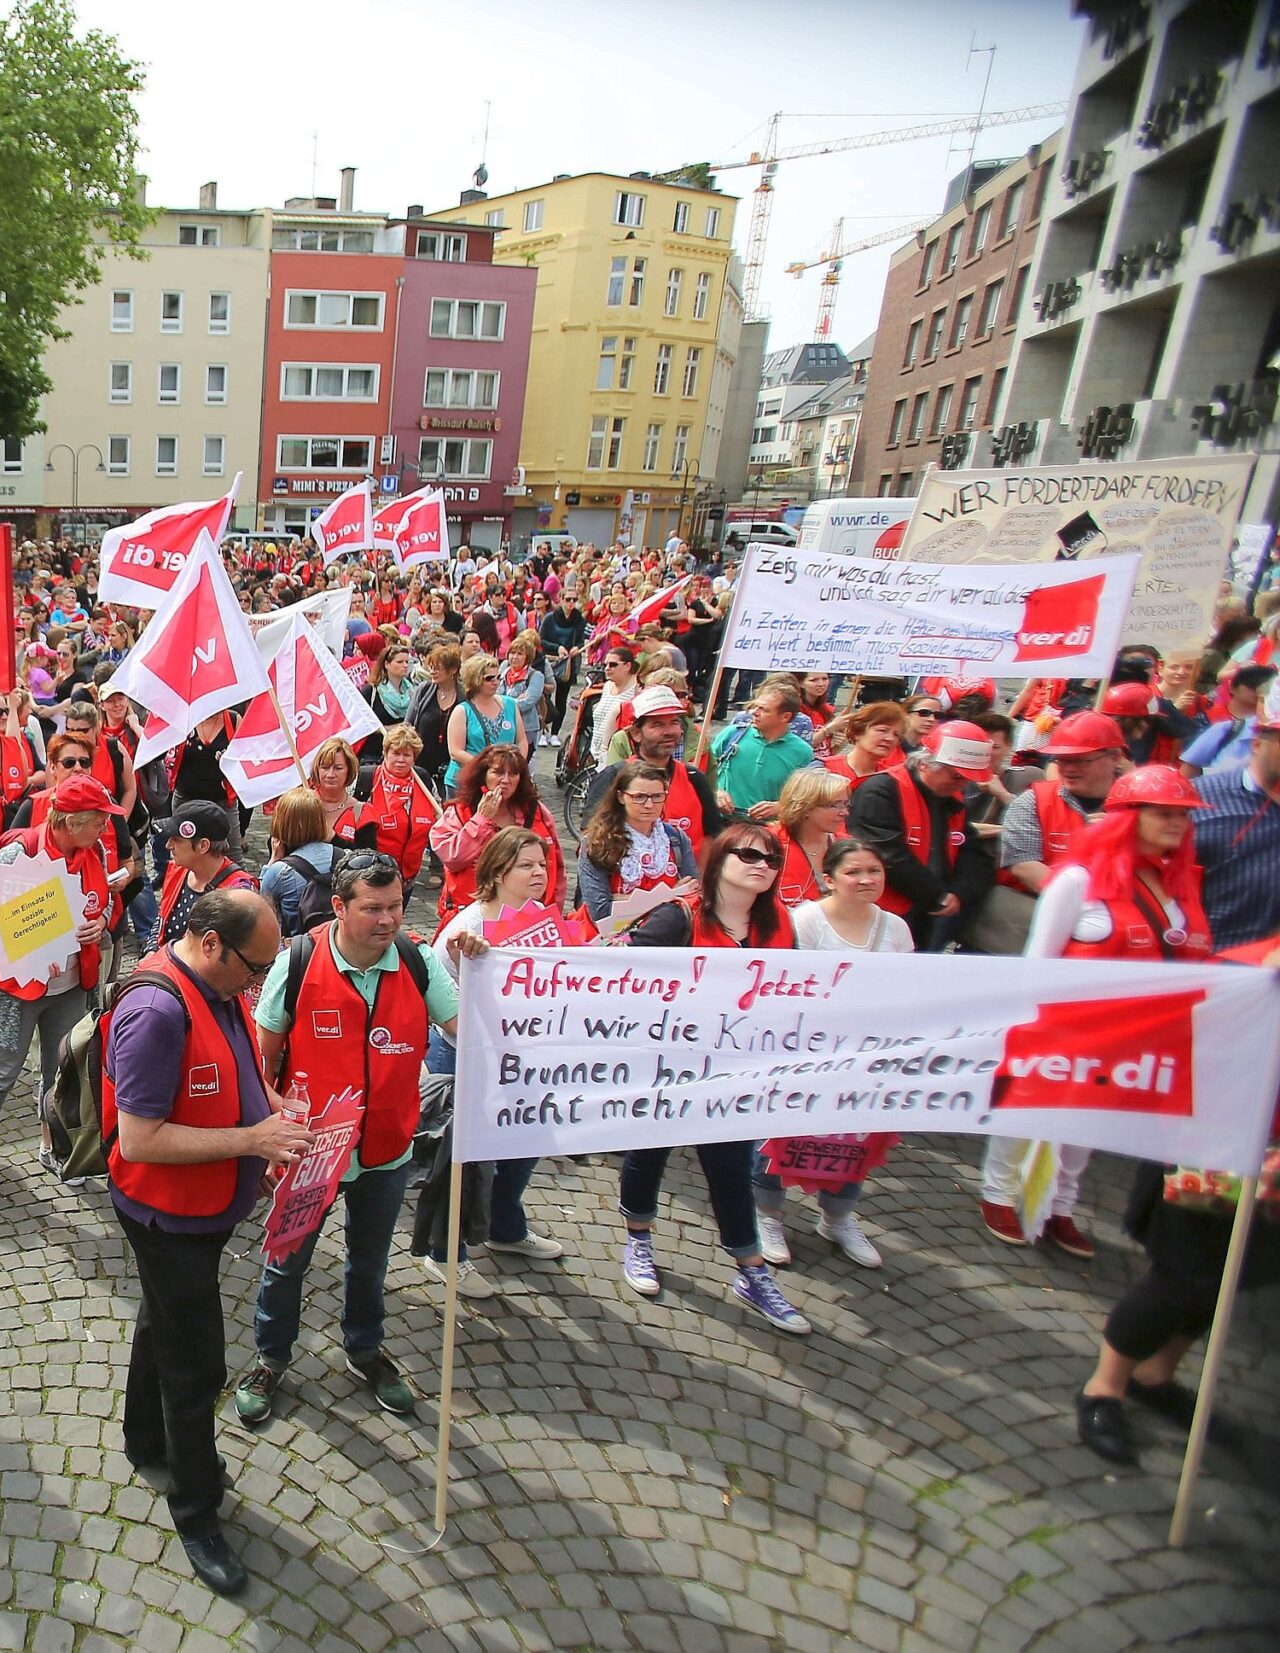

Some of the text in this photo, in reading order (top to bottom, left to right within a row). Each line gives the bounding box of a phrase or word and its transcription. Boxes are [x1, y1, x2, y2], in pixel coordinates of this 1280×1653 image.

[383, 479, 395, 490] U
[922, 482, 999, 523] WER
[838, 566, 869, 584] was
[870, 563, 892, 586] du
[820, 582, 851, 602] und
[878, 590, 912, 609] sag
[915, 585, 946, 603] dir
[950, 587, 981, 606] wer
[875, 619, 897, 635] die
[1021, 625, 1092, 647] ver.di
[1121, 619, 1195, 633] EAUFTRAGTE
[734, 635, 762, 650] den
[770, 633, 802, 651] Wert
[770, 653, 821, 670] besser
[830, 654, 885, 671] bezahlt
[21, 896, 46, 912] Einsatz
[45, 891, 56, 900] für
[21, 908, 45, 924] soziale
[501, 955, 853, 1011] Aufwertung! Jetzt!
[316, 1026, 339, 1034] ver.di
[501, 1004, 569, 1038] weil
[584, 1014, 641, 1041] wir
[648, 1008, 700, 1043] die
[714, 1012, 850, 1053] Kinder
[498, 1053, 631, 1087] Brunnen
[867, 1046, 1001, 1077] andere
[1007, 1053, 1177, 1094] ver.di
[191, 1081, 217, 1091] ver.di
[497, 1092, 584, 1129] nicht
[601, 1088, 694, 1121] mehr
[705, 1081, 822, 1120] weiter
[291, 1149, 336, 1192] GUT
[779, 1150, 865, 1174] JETZT!
[272, 1199, 325, 1238] JETZT!
